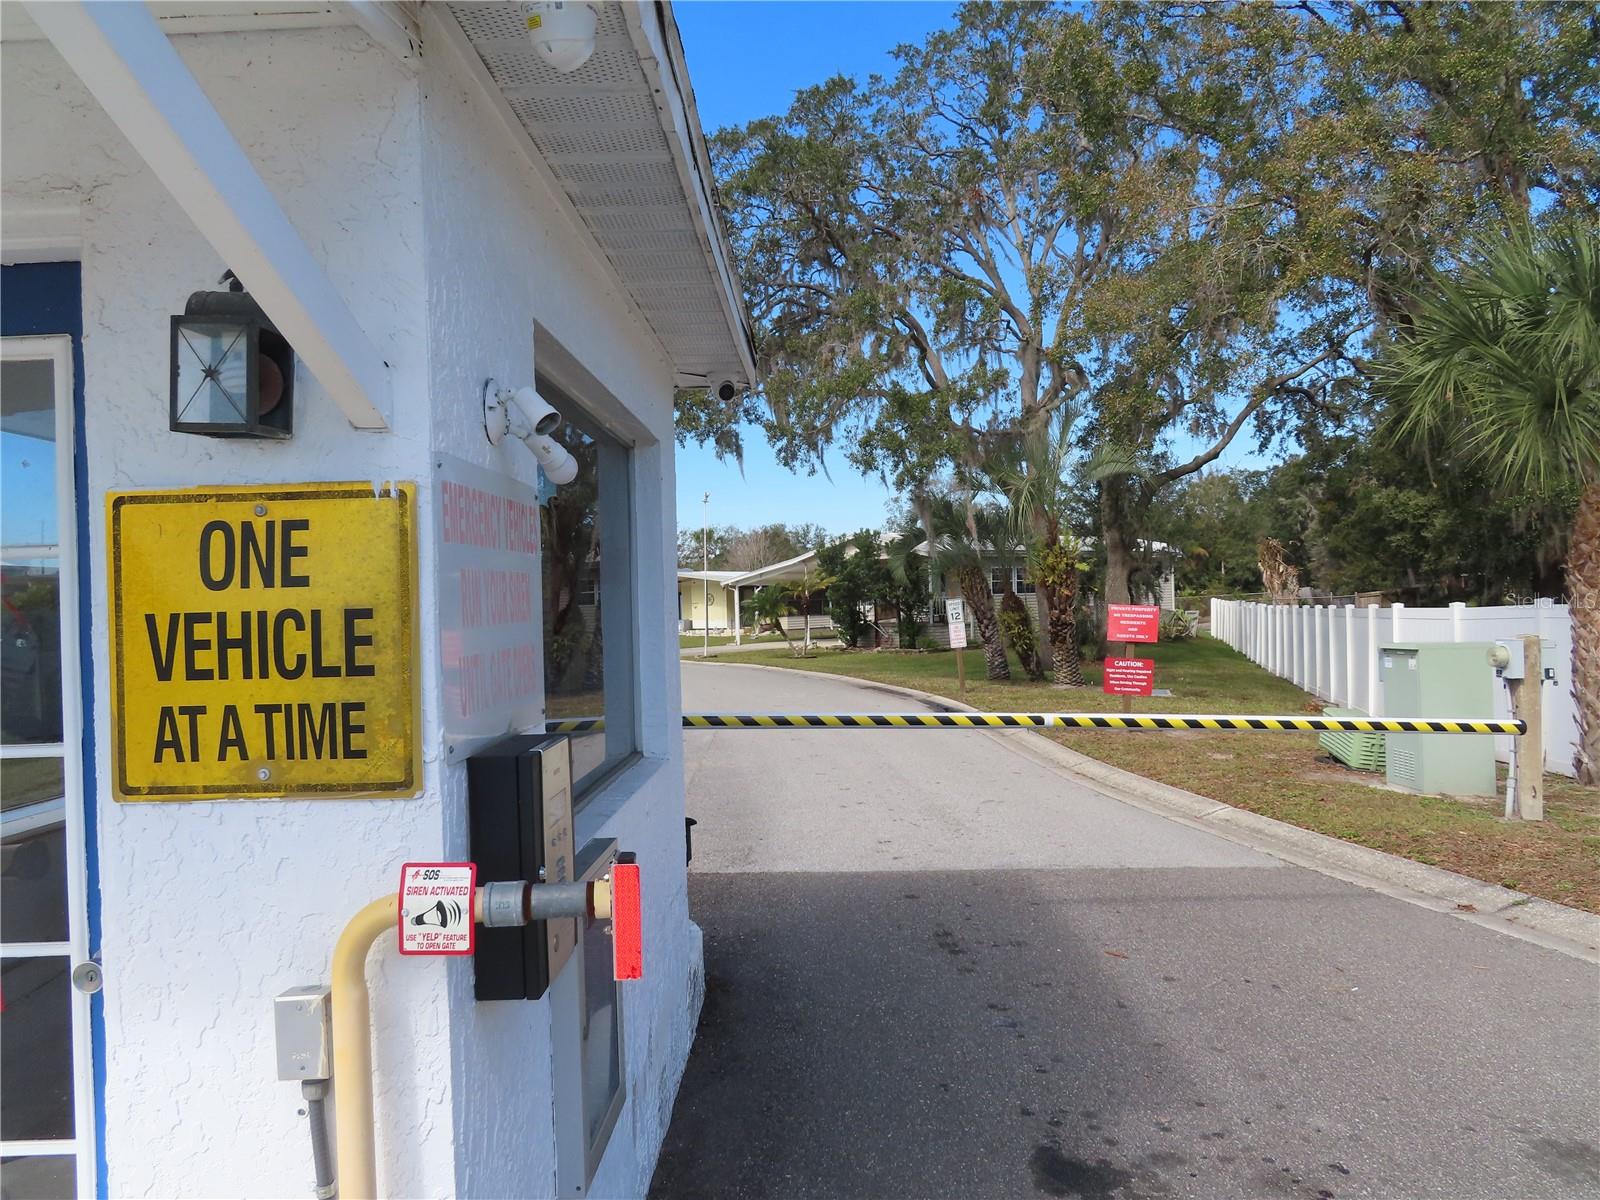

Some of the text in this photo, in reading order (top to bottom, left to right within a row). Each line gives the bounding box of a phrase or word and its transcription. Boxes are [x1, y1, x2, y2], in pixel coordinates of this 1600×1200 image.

[200, 519, 310, 591] ONE
[951, 612, 961, 621] 12
[145, 608, 375, 682] VEHICLE
[1114, 660, 1144, 668] CAUTION:
[154, 702, 368, 763] AT A TIME
[422, 869, 440, 880] SOS
[406, 886, 469, 896] SIREN ACTIVATED
